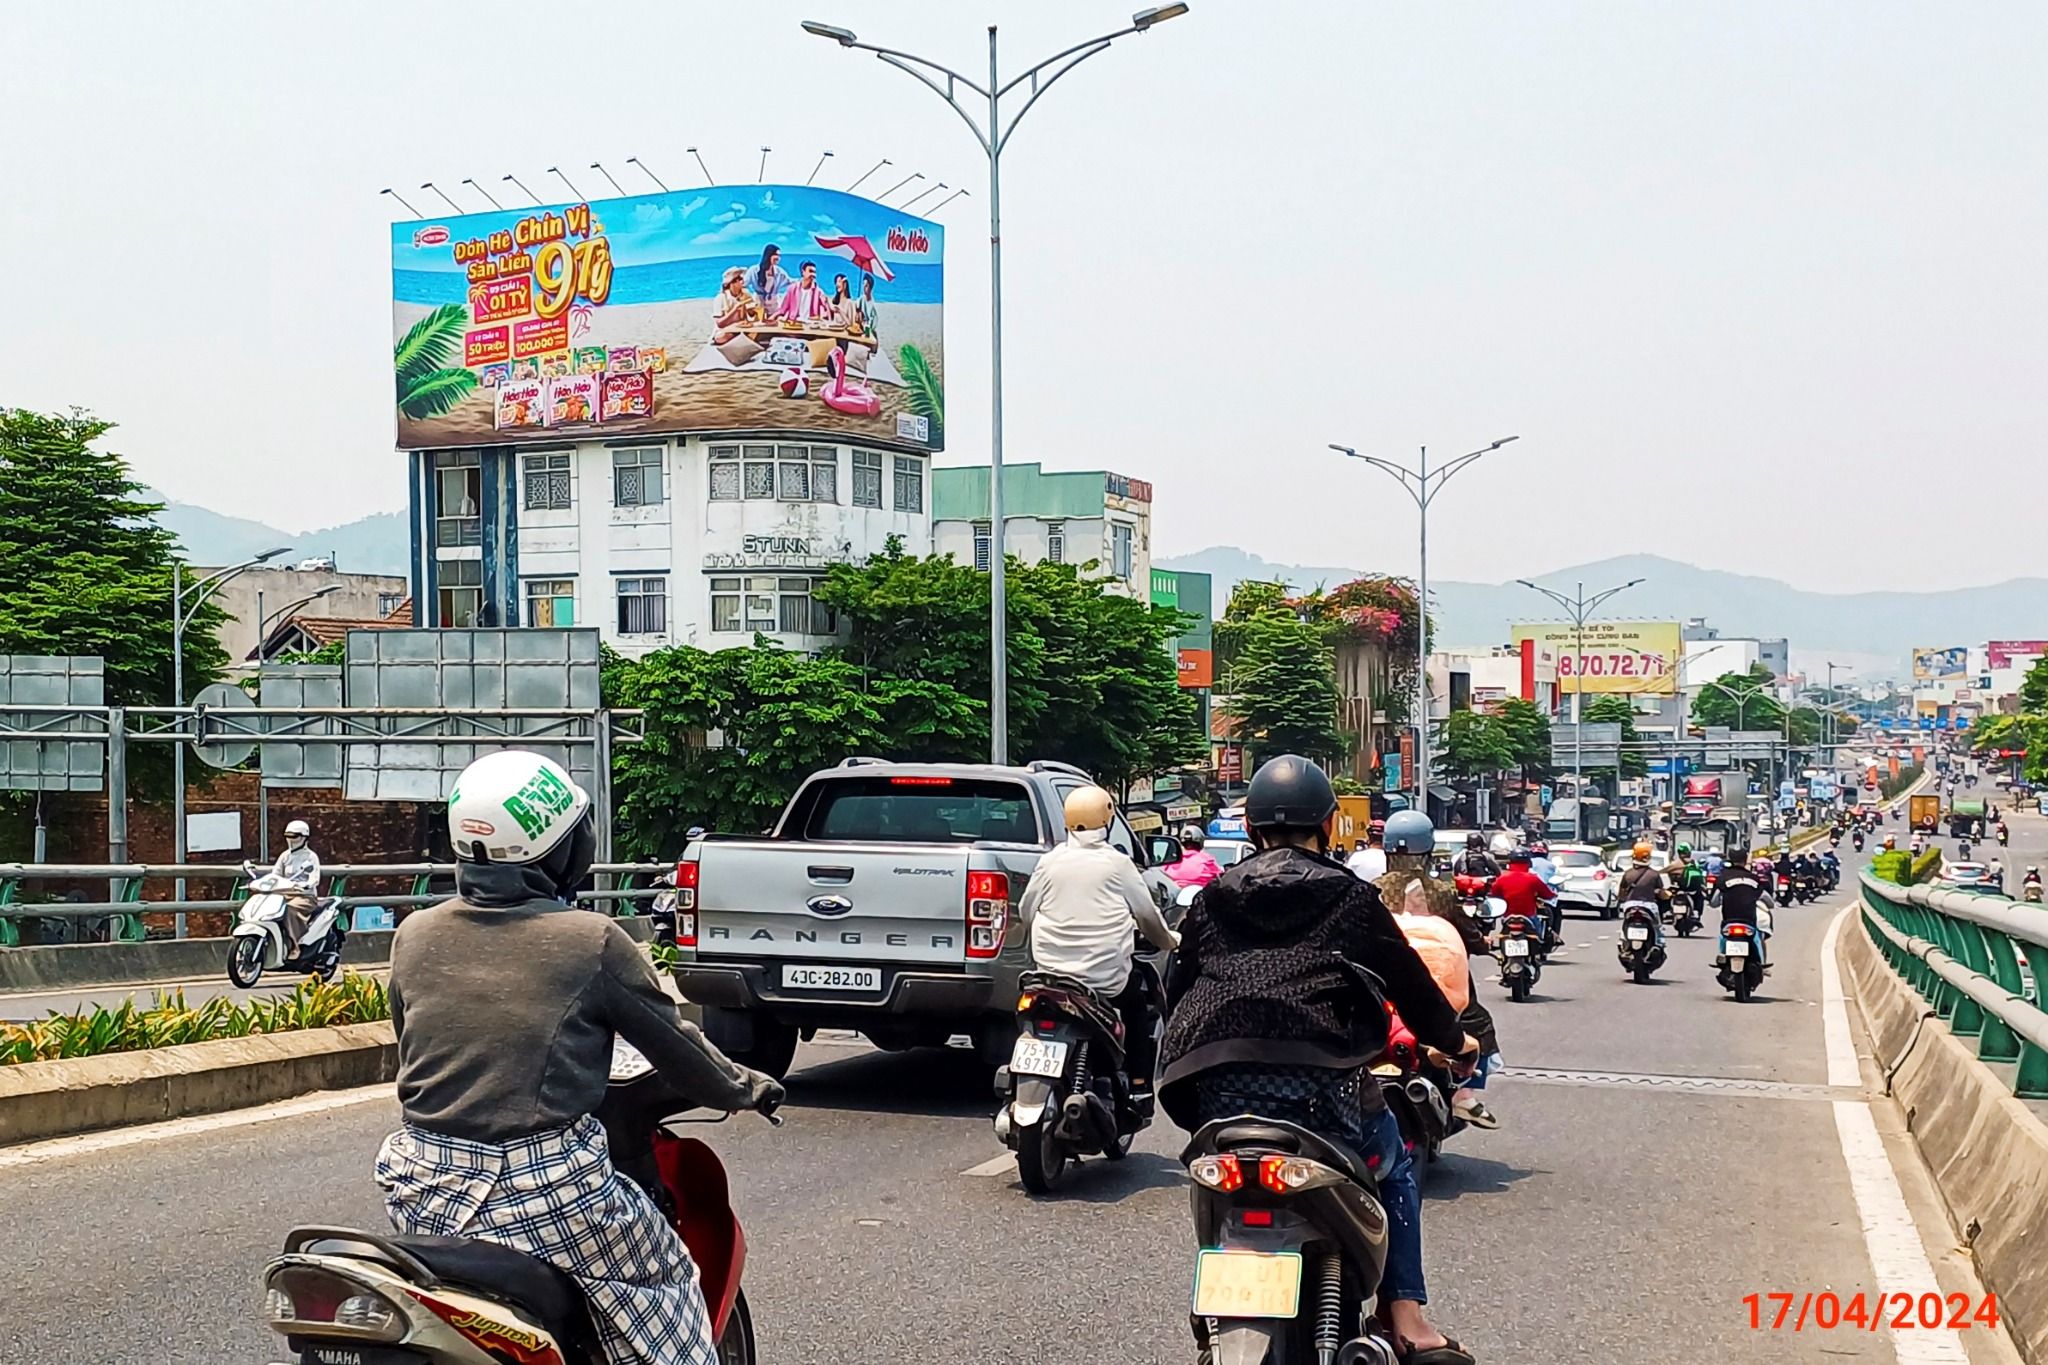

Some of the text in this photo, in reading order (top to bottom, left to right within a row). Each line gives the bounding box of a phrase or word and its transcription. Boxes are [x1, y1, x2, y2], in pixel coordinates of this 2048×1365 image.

[515, 213, 564, 245] Chín
[566, 204, 589, 236] Vị
[887, 226, 929, 253] Hảo Hảo
[490, 294, 506, 310] 01
[469, 343, 481, 356] 50
[709, 927, 953, 948] RANGER
[1015, 1056, 1060, 1073] 497.87
[314, 1349, 361, 1365] AMAHA
